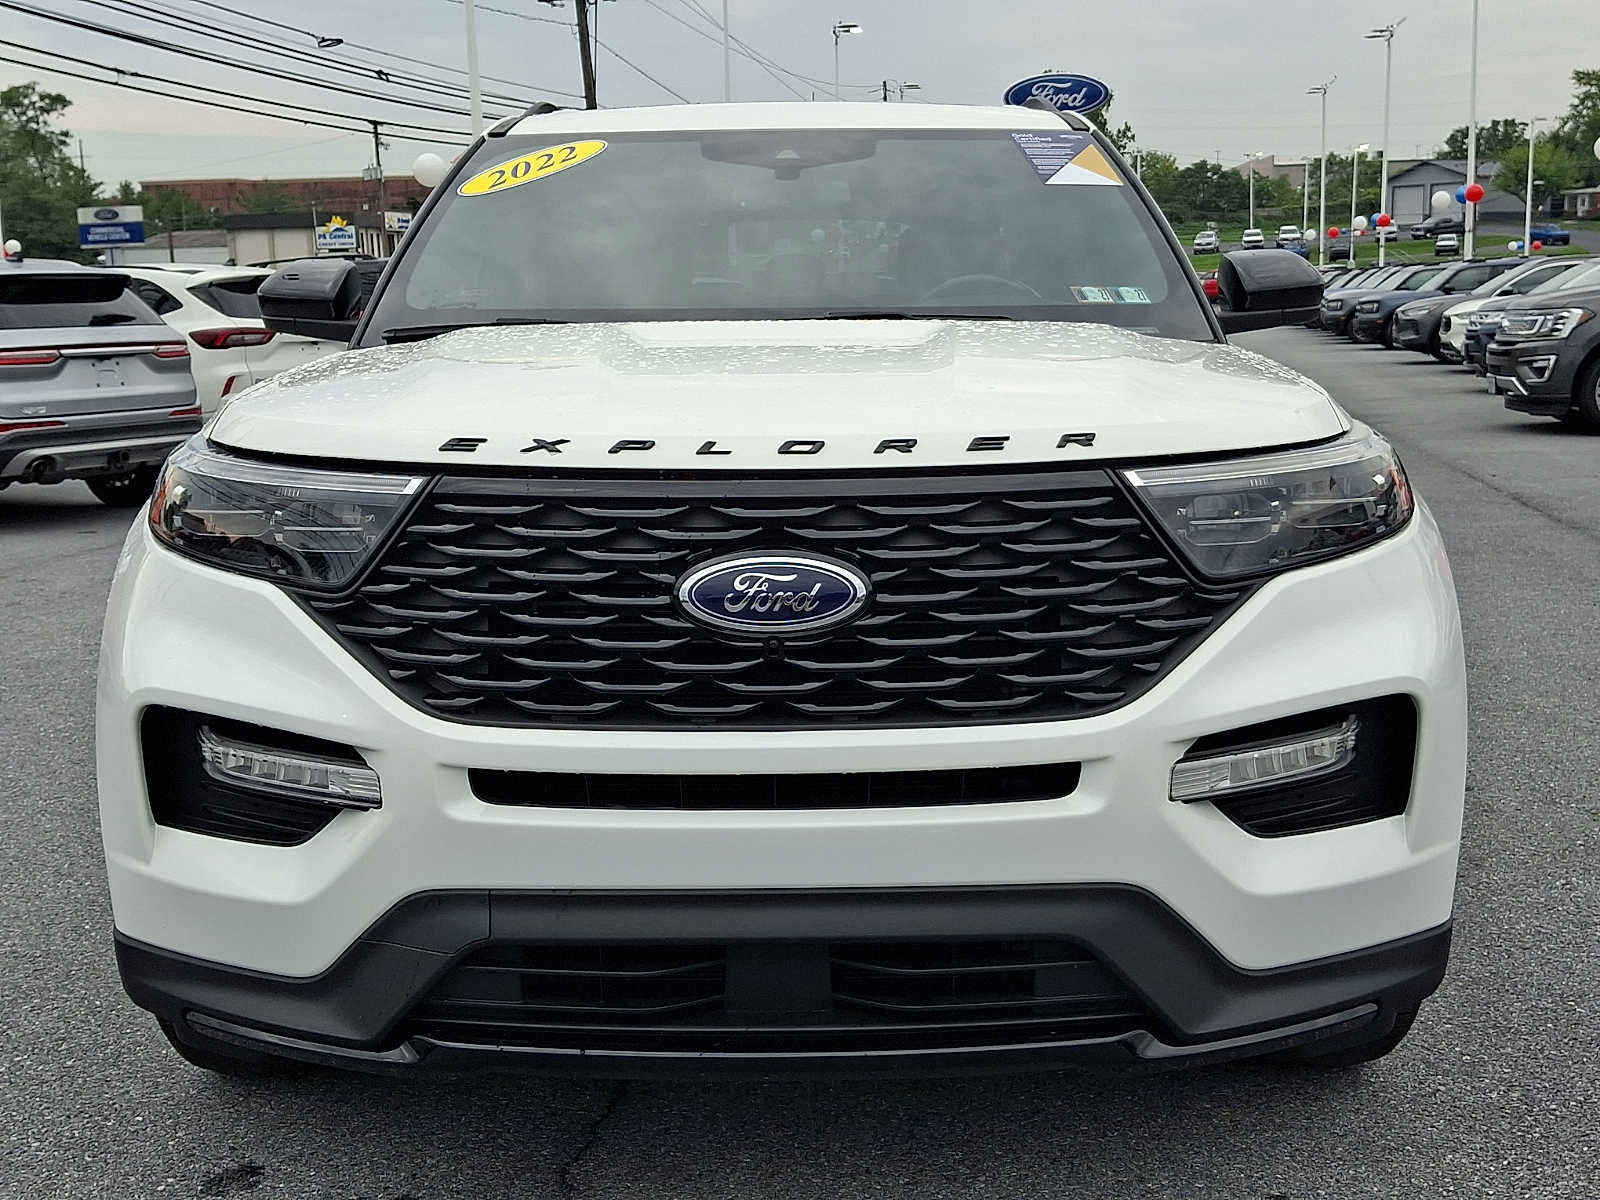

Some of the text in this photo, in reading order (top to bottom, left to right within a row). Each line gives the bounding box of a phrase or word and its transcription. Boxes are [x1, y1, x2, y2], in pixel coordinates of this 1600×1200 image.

[1031, 82, 1088, 108] Ford
[487, 146, 577, 190] 2022
[438, 432, 1097, 455] EXPLORER
[724, 572, 822, 613] Ford
